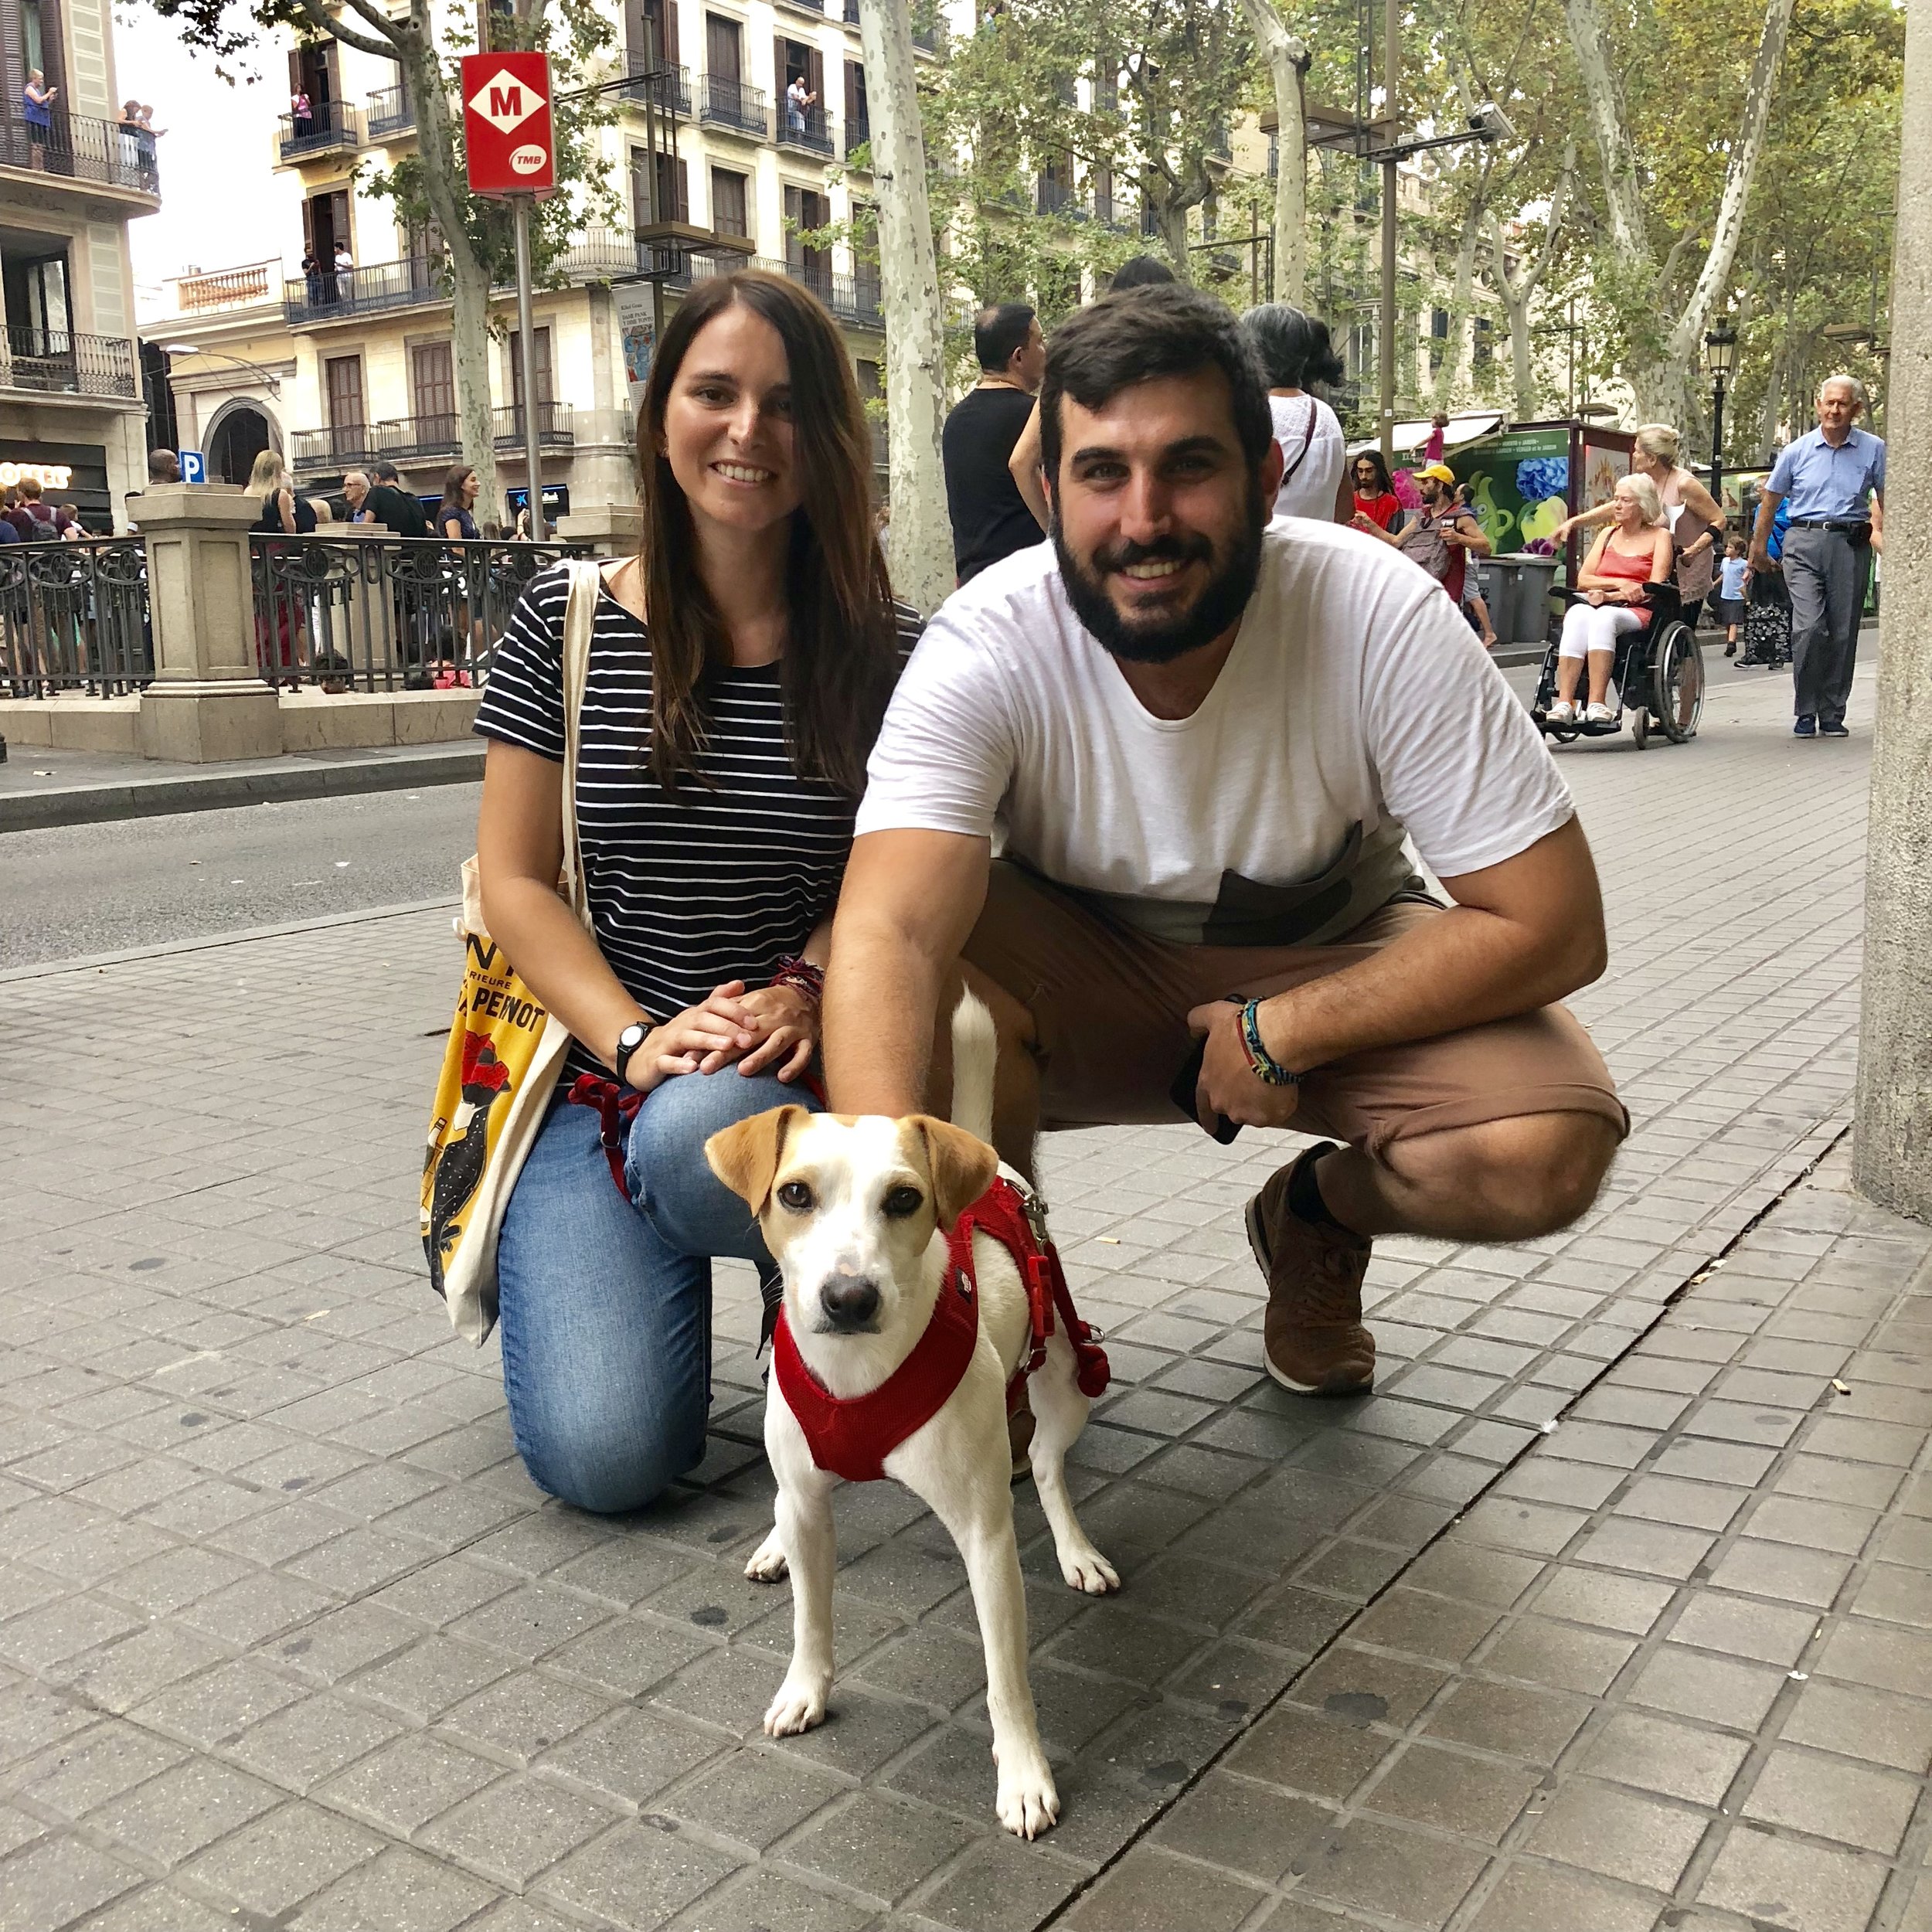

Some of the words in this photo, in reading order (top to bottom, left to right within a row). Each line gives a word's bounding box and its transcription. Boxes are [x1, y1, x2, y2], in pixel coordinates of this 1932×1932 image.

[490, 87, 522, 117] M
[517, 156, 542, 165] TMB
[184, 454, 200, 483] P
[468, 970, 512, 990] RIEURE
